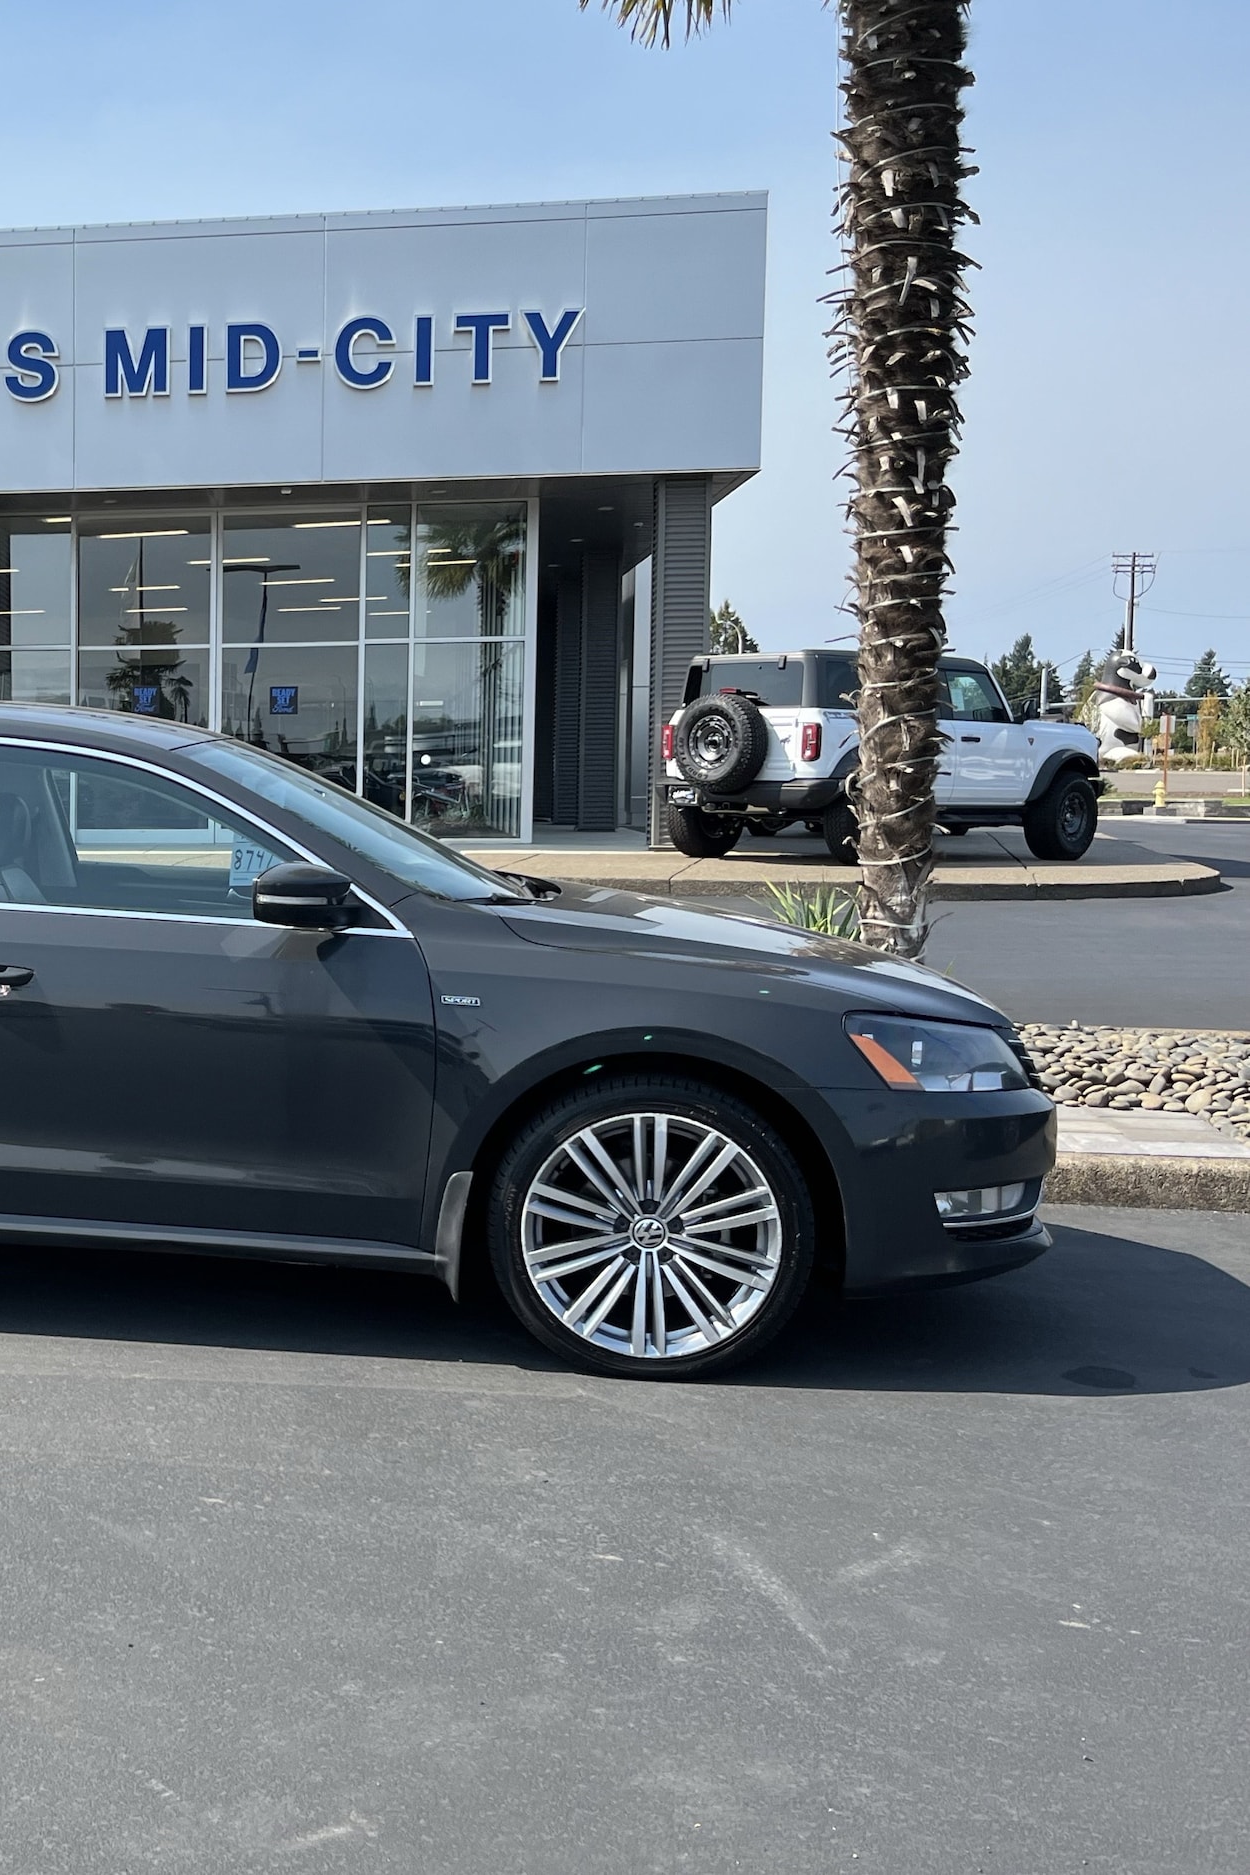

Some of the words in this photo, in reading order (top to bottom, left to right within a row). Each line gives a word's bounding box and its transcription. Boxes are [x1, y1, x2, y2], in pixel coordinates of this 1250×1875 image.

[104, 307, 587, 398] MID-CITY
[272, 688, 295, 696] READY
[277, 696, 290, 704] SET
[444, 996, 477, 1004] SPORT
